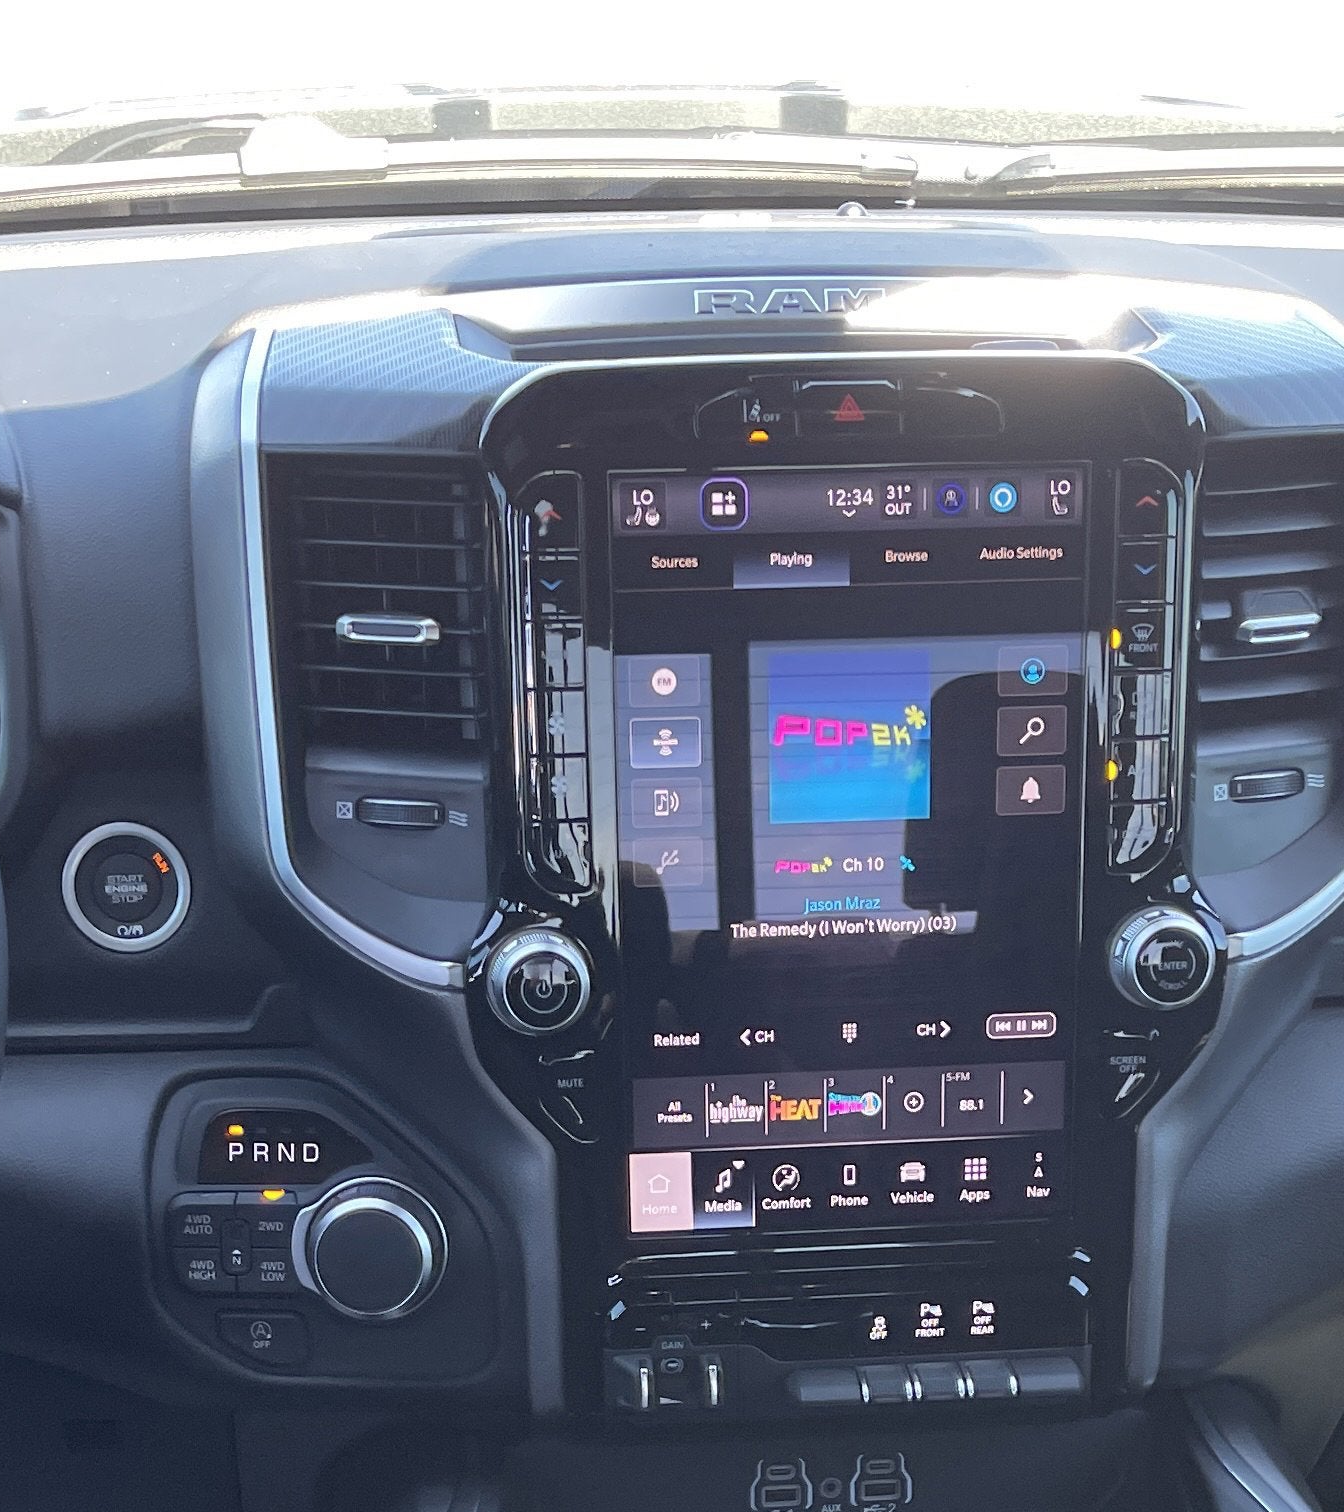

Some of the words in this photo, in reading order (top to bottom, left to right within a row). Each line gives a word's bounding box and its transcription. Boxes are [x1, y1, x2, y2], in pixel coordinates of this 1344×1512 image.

[694, 287, 886, 314] RAM
[763, 412, 780, 423] OFF
[886, 484, 911, 500] 31°
[1050, 479, 1072, 496] LO
[632, 488, 654, 506] LO
[826, 487, 874, 507] 12:34
[884, 502, 913, 516] OUT
[769, 550, 813, 568] Playing
[885, 549, 929, 563] Browse
[979, 547, 1015, 560] Audio
[1016, 546, 1064, 562] Settings
[650, 555, 699, 570] Sources
[657, 677, 672, 687] FM
[842, 857, 863, 873] Ch
[866, 856, 885, 872] 10
[107, 874, 144, 883] START
[104, 883, 148, 893] ENGINE
[803, 897, 842, 915] Jason
[845, 896, 881, 911] Mraz
[730, 922, 757, 939] The
[759, 920, 817, 939] Remedy
[831, 918, 875, 936] Won't
[875, 917, 926, 936] Worry)
[927, 915, 958, 933] (03)
[1158, 960, 1188, 971] ENTER
[916, 1023, 937, 1037] CH
[653, 1030, 700, 1048] Related
[754, 1029, 775, 1045] CH
[1109, 1055, 1147, 1066] SCREEN
[557, 1078, 584, 1088] MUTE
[768, 1079, 776, 1090] 2
[886, 1075, 894, 1085] 4
[668, 1101, 682, 1112] All
[709, 1100, 764, 1124] highway
[769, 1098, 822, 1122] HEAT
[657, 1112, 693, 1124] Presets
[959, 1188, 991, 1203] Apps
[1026, 1185, 1052, 1198] Nav
[830, 1194, 869, 1207] Phone
[890, 1190, 935, 1205] Vehicle
[642, 1203, 678, 1215] Home
[705, 1199, 743, 1213] Media
[761, 1196, 812, 1211] Comfort
[185, 1214, 211, 1225] 4WD
[183, 1224, 213, 1235] AUTO
[258, 1221, 284, 1232] 2WD
[189, 1260, 215, 1270] 4WD
[232, 1255, 242, 1266] N
[260, 1261, 285, 1271] 4WD
[188, 1270, 216, 1280] HIGH
[261, 1271, 286, 1282] LOW
[921, 1318, 940, 1328] OFF
[973, 1315, 992, 1325] OFF
[869, 1330, 888, 1341] OFF
[915, 1327, 946, 1338] FRONT
[970, 1325, 995, 1336] REAR
[253, 1340, 271, 1349] OFF
[661, 1341, 685, 1350] GAIN
[821, 1503, 842, 1512] AUX
